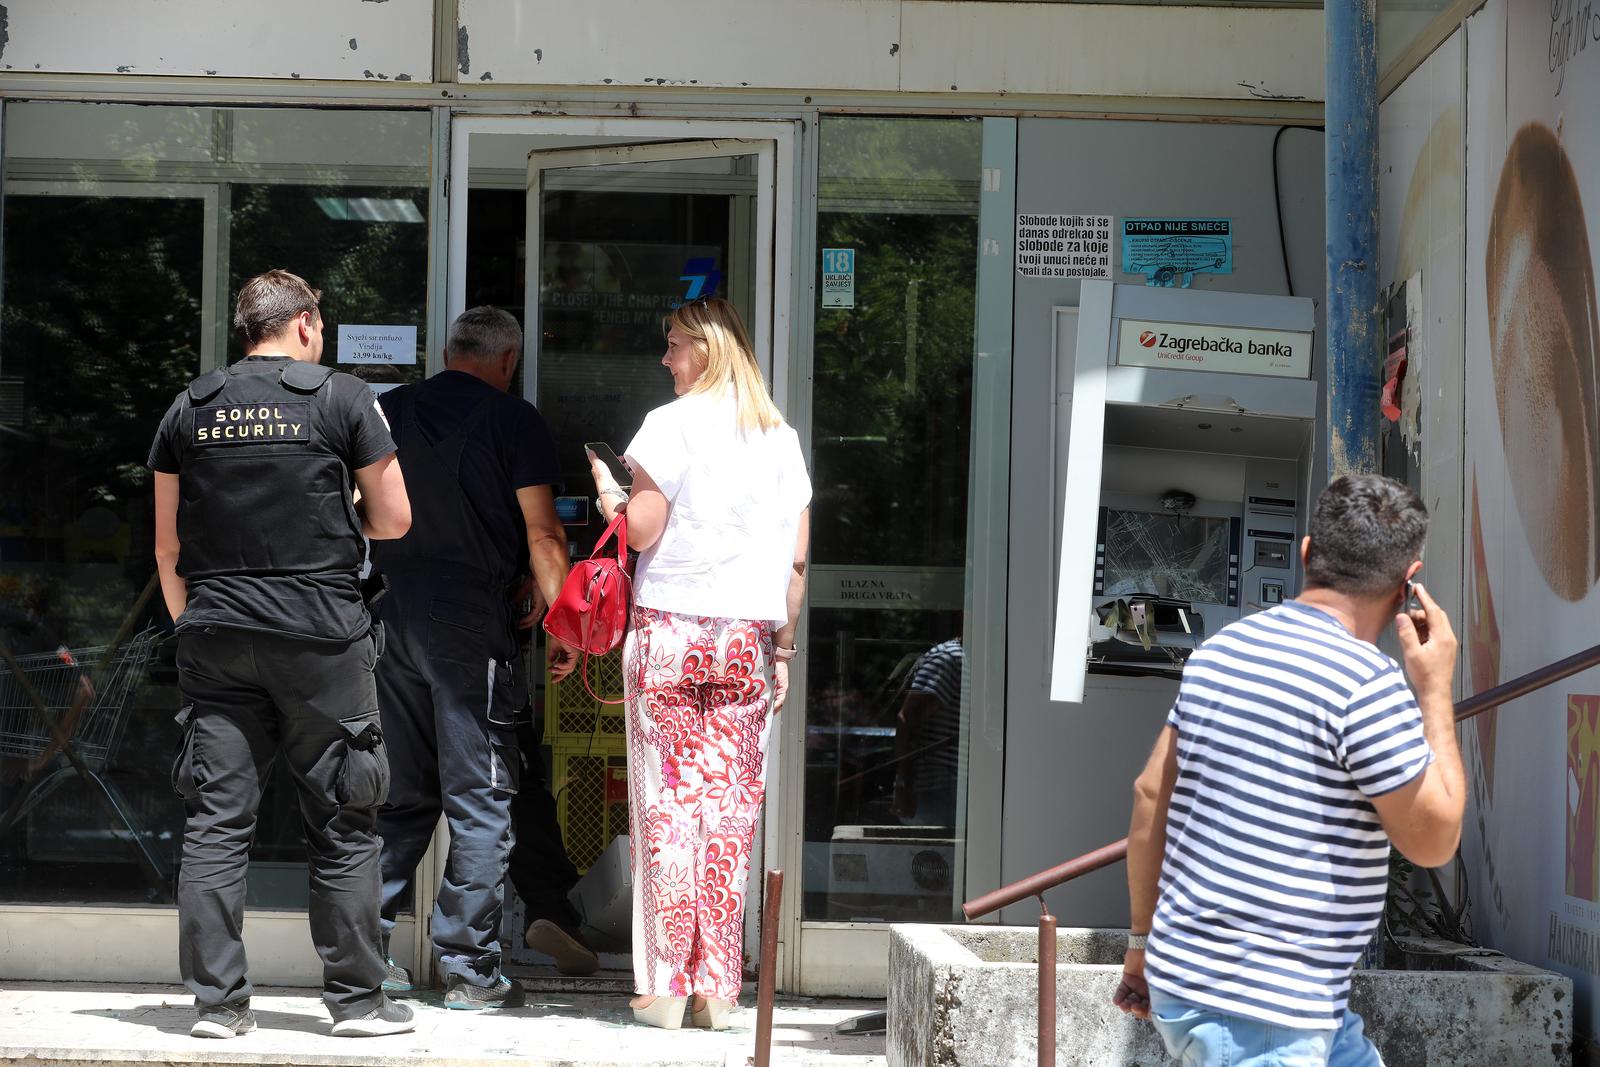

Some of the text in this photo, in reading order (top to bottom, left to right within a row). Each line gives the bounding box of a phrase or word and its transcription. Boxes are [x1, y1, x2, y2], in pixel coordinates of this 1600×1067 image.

[1019, 215, 1109, 228] Slobode kojih si se
[1126, 222, 1162, 231] OTPAD
[1164, 222, 1188, 231] NIJE
[1019, 227, 1109, 240] danas odrekao su
[1019, 239, 1109, 254] slobode za koje
[826, 251, 850, 273] 18
[1019, 253, 1108, 266] tvoji unuci neće ni
[1041, 266, 1053, 276] da
[1054, 267, 1065, 276] su
[1066, 266, 1109, 278] postojale.
[825, 280, 852, 288] SAVJEST
[603, 293, 625, 307] THE
[1158, 333, 1292, 357] Zagrebačka banka
[1157, 351, 1204, 363] UniCredit Group
[215, 407, 282, 422] SOKOL
[197, 424, 302, 440] SECURITY
[840, 591, 877, 601] DRUGA
